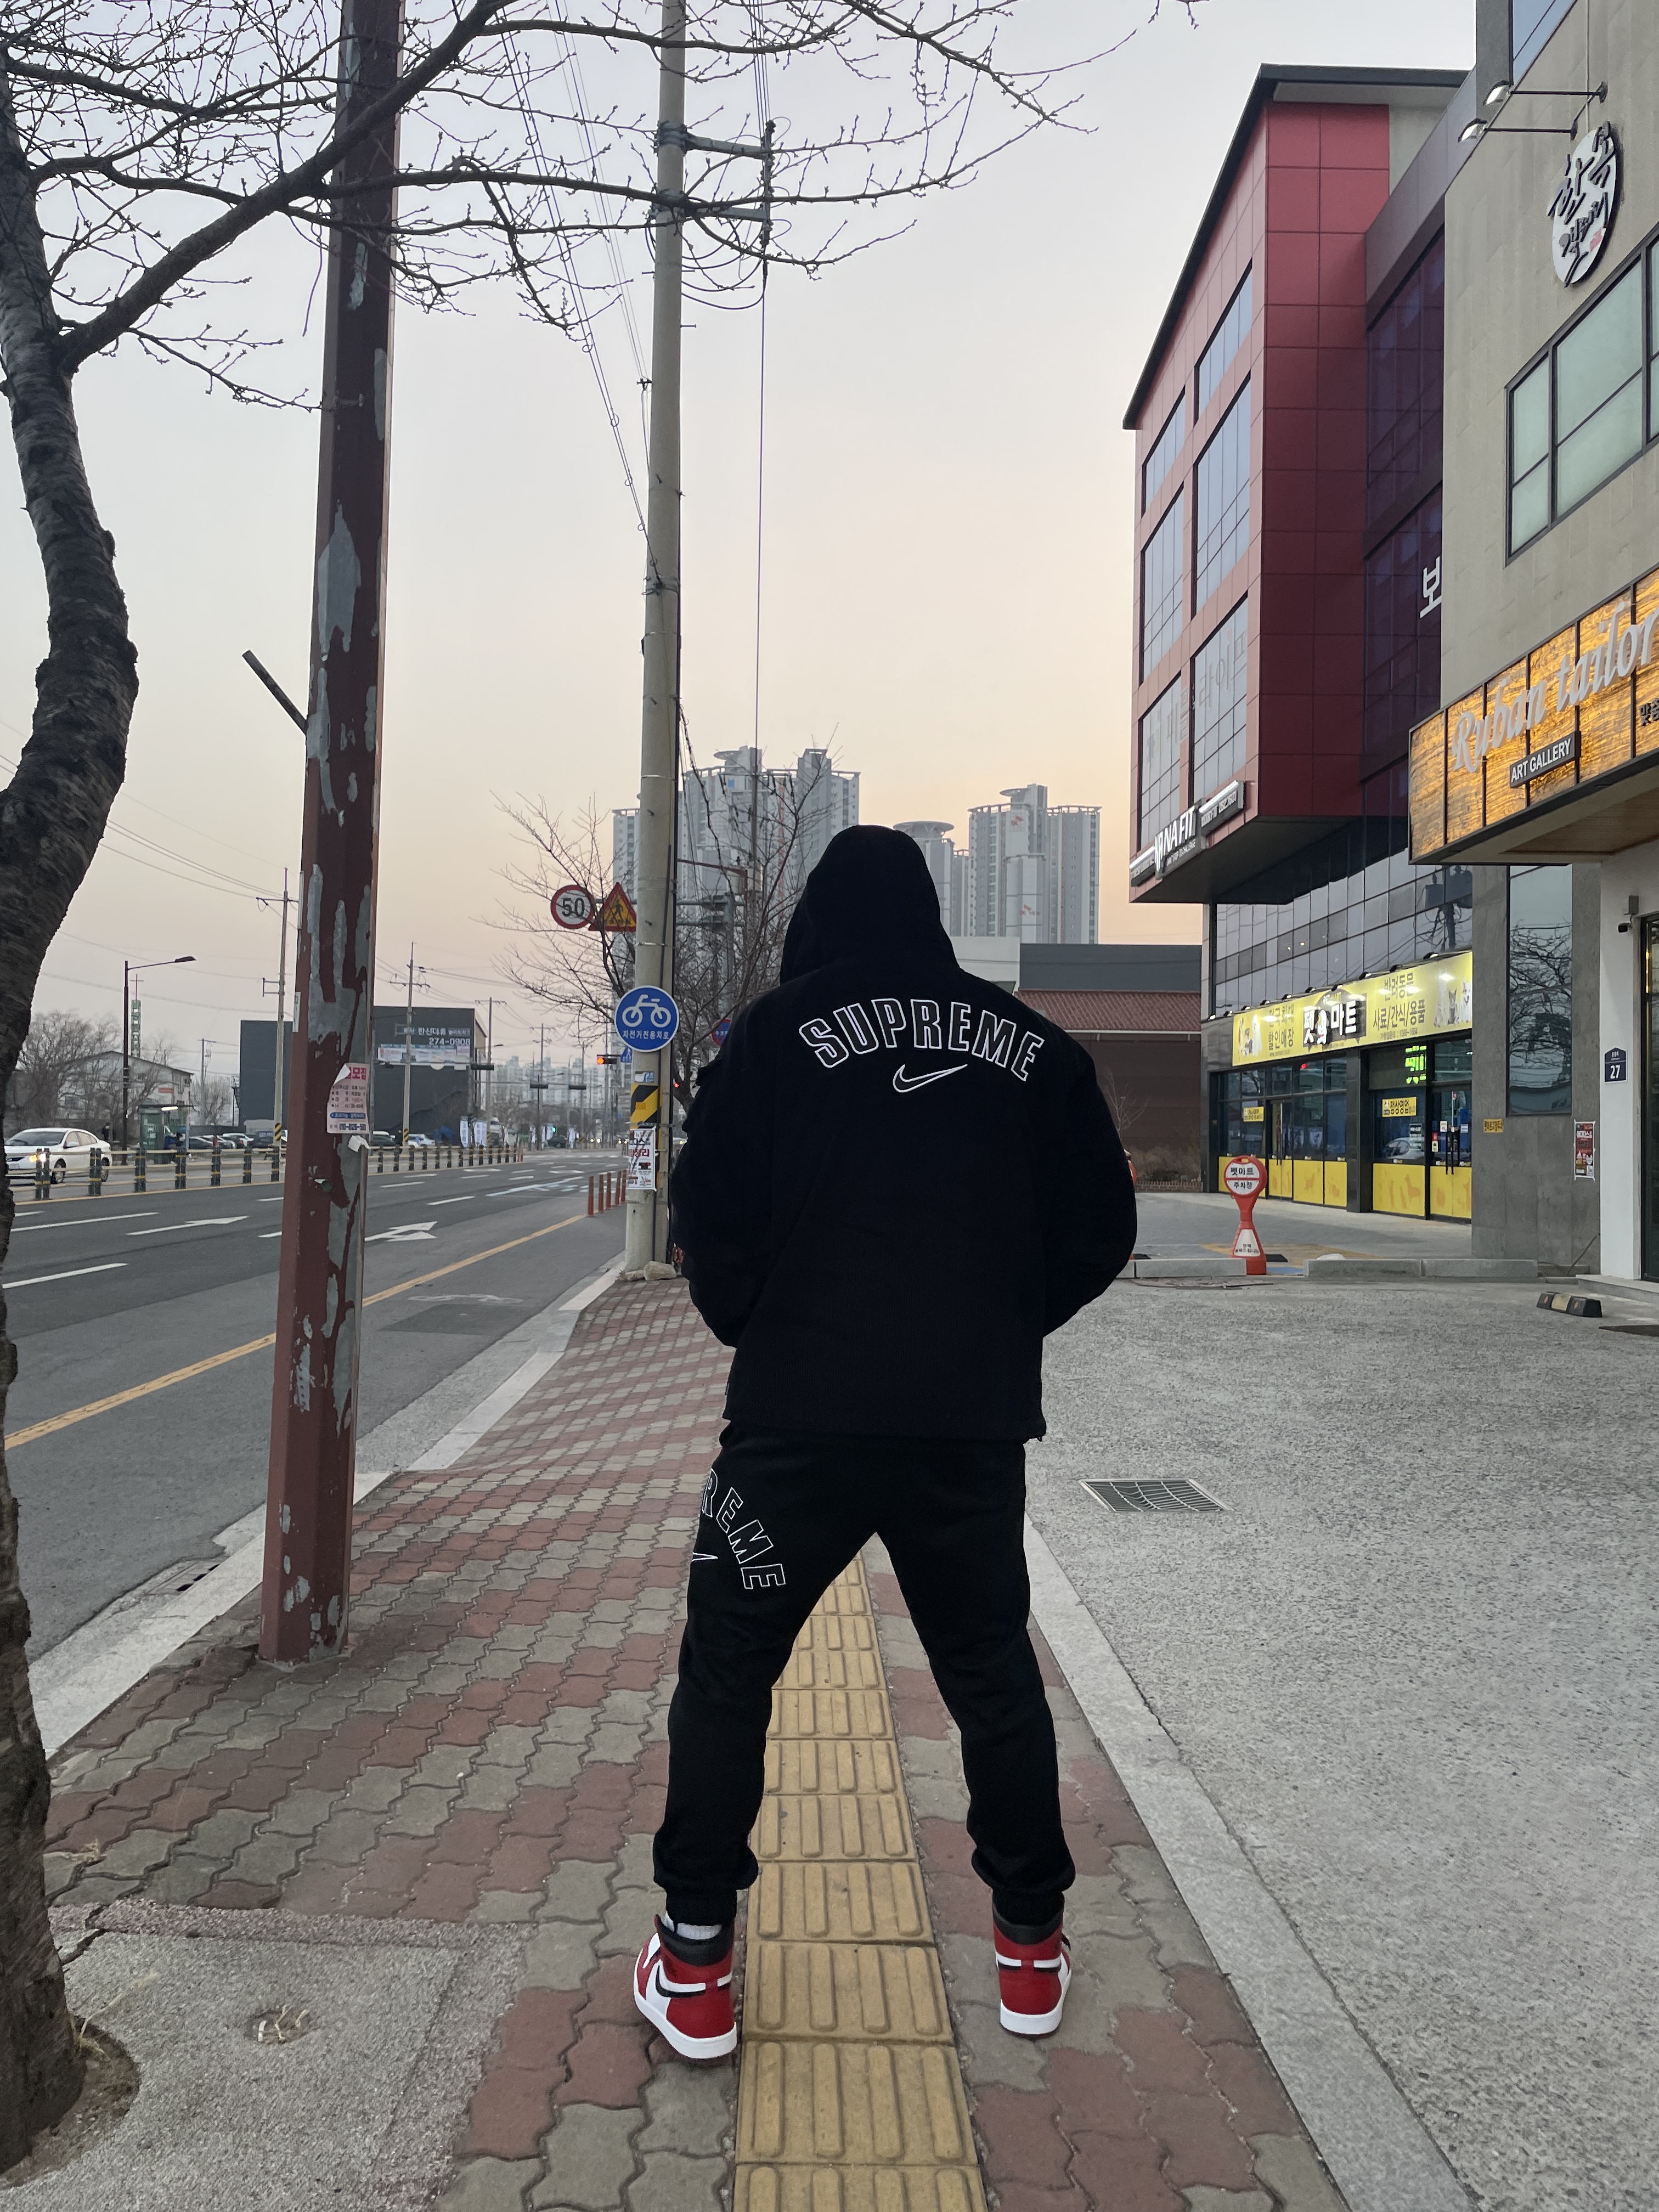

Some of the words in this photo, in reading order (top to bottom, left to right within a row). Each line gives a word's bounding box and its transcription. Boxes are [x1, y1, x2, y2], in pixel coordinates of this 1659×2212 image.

[1452, 677, 1548, 774] Ruban
[1556, 601, 1659, 713] tailor
[1511, 759, 1527, 783] ART
[1529, 738, 1572, 774] GALLERY
[562, 897, 585, 917] 50
[1373, 998, 1425, 1031] 사료/간식/용품
[623, 1030, 669, 1040] 자전거전용차로
[799, 998, 1045, 1082] SUPREME
[1268, 1027, 1294, 1051] 할인매장
[1610, 1064, 1621, 1079] 27
[1390, 1099, 1409, 1114] 정상영업
[1231, 1166, 1254, 1176] 펫마트
